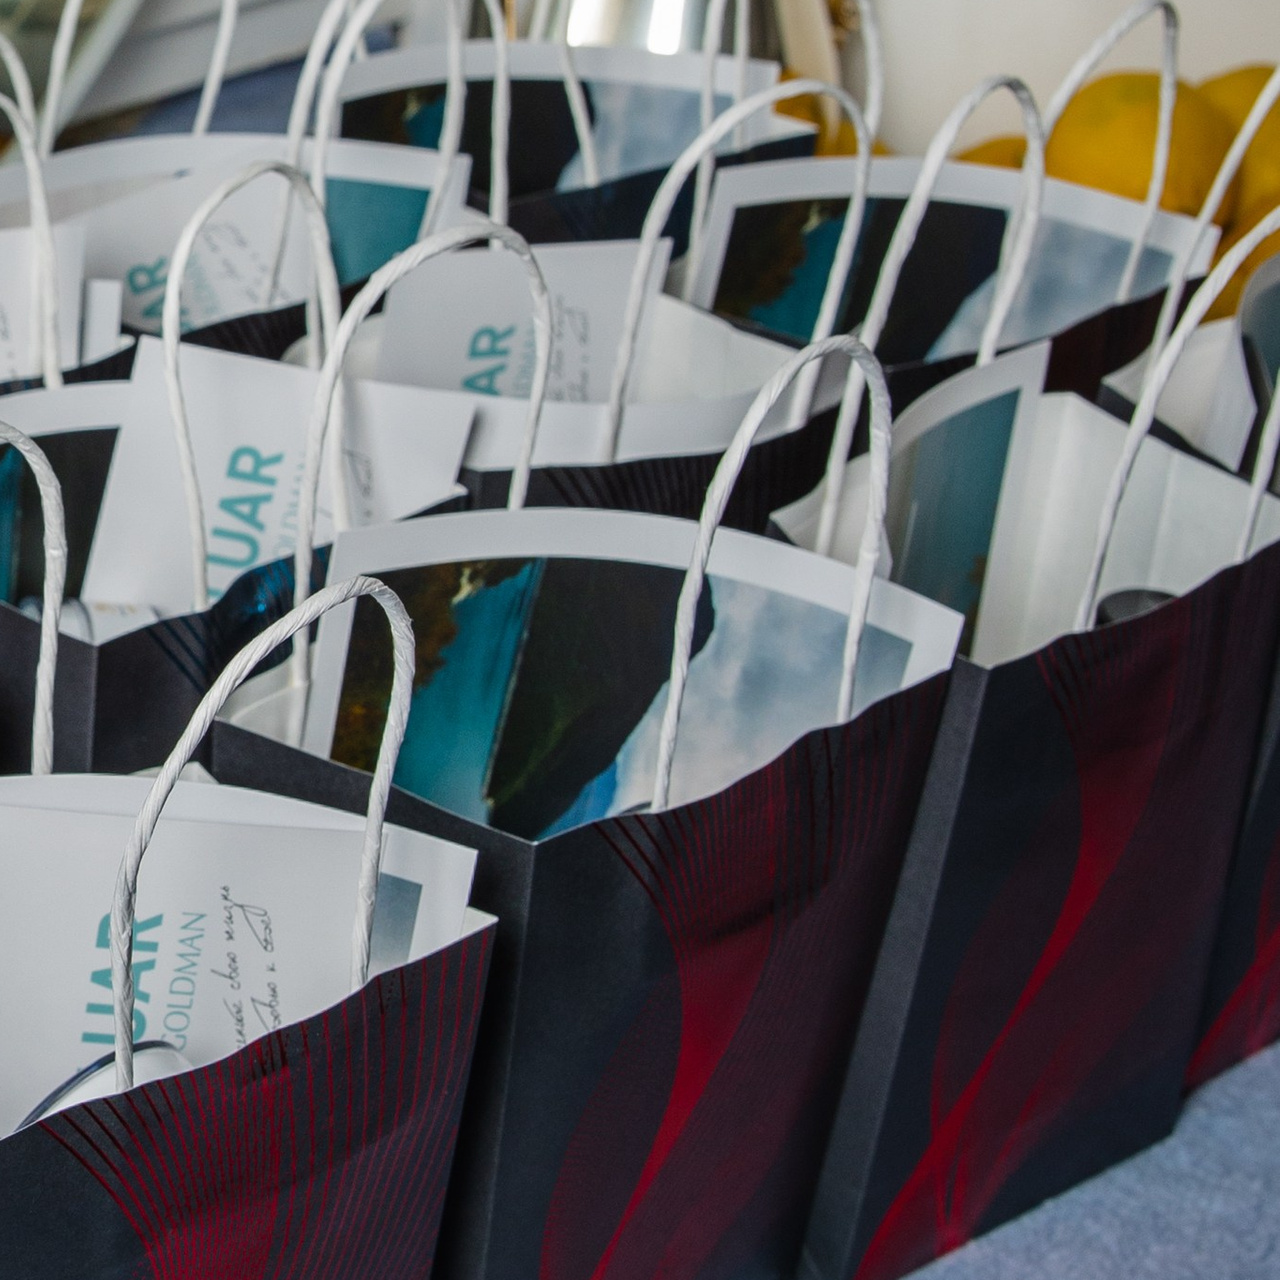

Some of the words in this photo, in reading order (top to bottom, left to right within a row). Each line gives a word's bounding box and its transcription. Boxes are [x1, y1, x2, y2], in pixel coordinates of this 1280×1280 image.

[462, 325, 518, 397] AR
[207, 445, 285, 582] UAR
[80, 911, 164, 1045] UAR
[160, 911, 208, 1053] GOLDMAN
